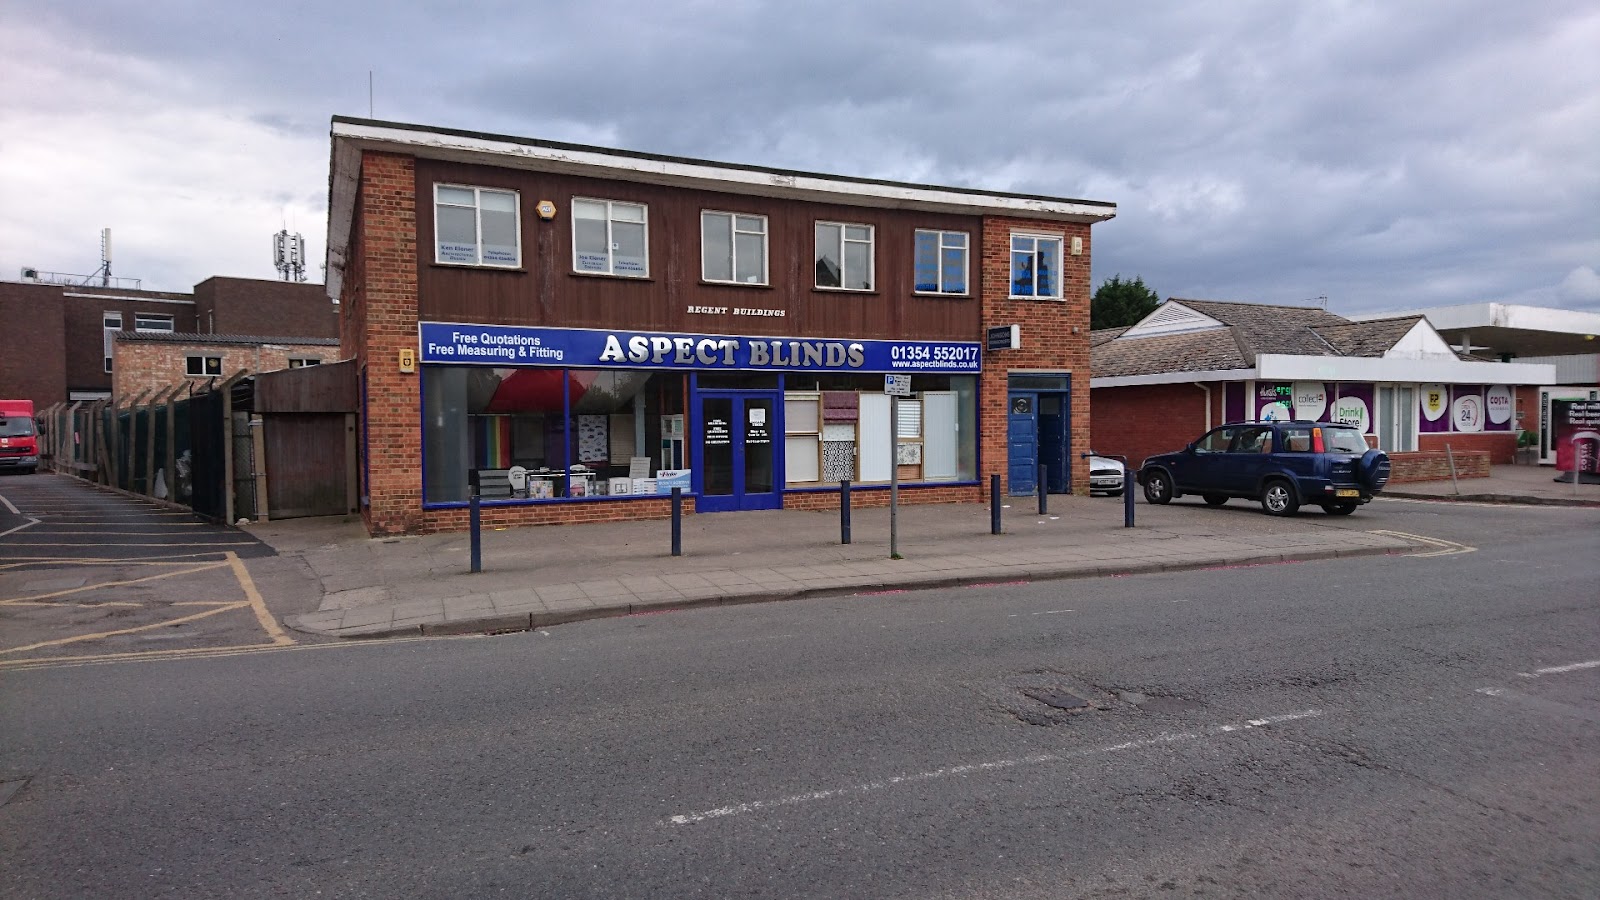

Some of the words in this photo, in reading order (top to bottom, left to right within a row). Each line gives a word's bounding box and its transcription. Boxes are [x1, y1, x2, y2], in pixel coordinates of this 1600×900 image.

[687, 305, 728, 315] REGENT
[733, 307, 785, 317] BUILDINGS
[452, 332, 478, 343] Free
[480, 333, 540, 346] Quotations
[428, 343, 454, 355] Free
[457, 344, 516, 359] Measuring
[518, 346, 527, 357] &
[529, 346, 564, 360] Fitting
[599, 334, 740, 365] ASPECT
[748, 340, 865, 367] BLINDS
[891, 346, 930, 360] 01354
[933, 347, 978, 360] 552017
[892, 360, 978, 369] www.aspectblinds.co.uk
[1490, 396, 1508, 405] COSTA
[1461, 410, 1471, 421] 24
